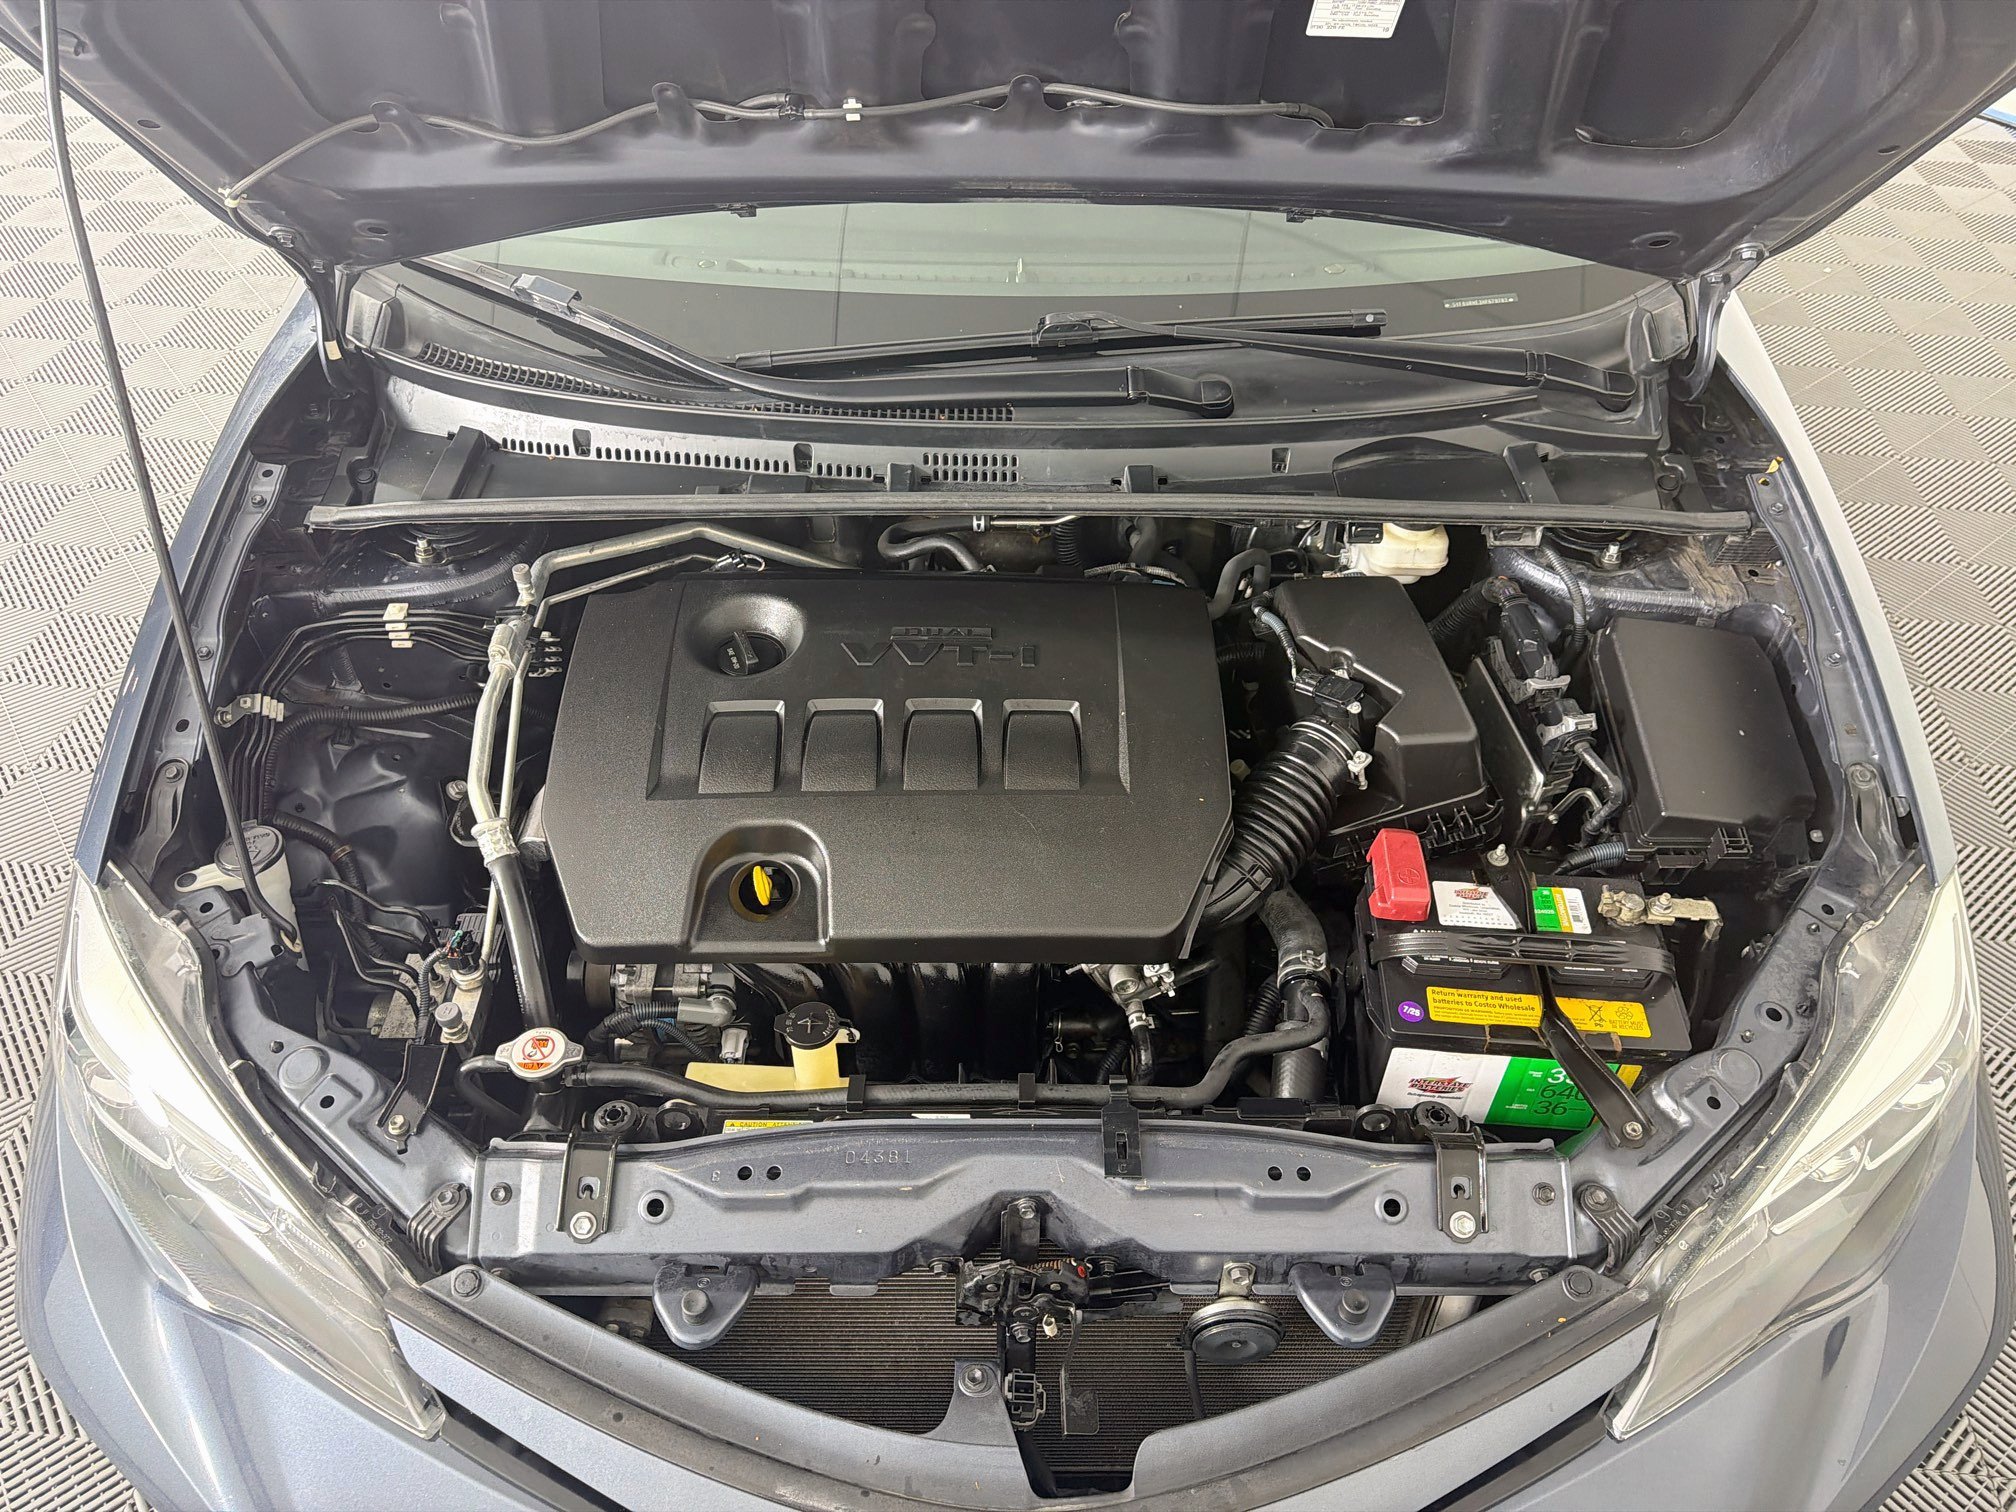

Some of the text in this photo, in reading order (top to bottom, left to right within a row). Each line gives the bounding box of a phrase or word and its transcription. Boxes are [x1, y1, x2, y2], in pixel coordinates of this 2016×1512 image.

[1431, 989, 1456, 998] Return
[1457, 991, 1488, 1001] warranty
[1505, 995, 1522, 1003] used
[1432, 997, 1464, 1006] batteries
[1473, 1000, 1497, 1009] Costco
[1498, 1002, 1536, 1012] Wholesale
[1409, 1078, 1472, 1089] INTERSTATE
[1409, 1083, 1466, 1093] BATTERIES
